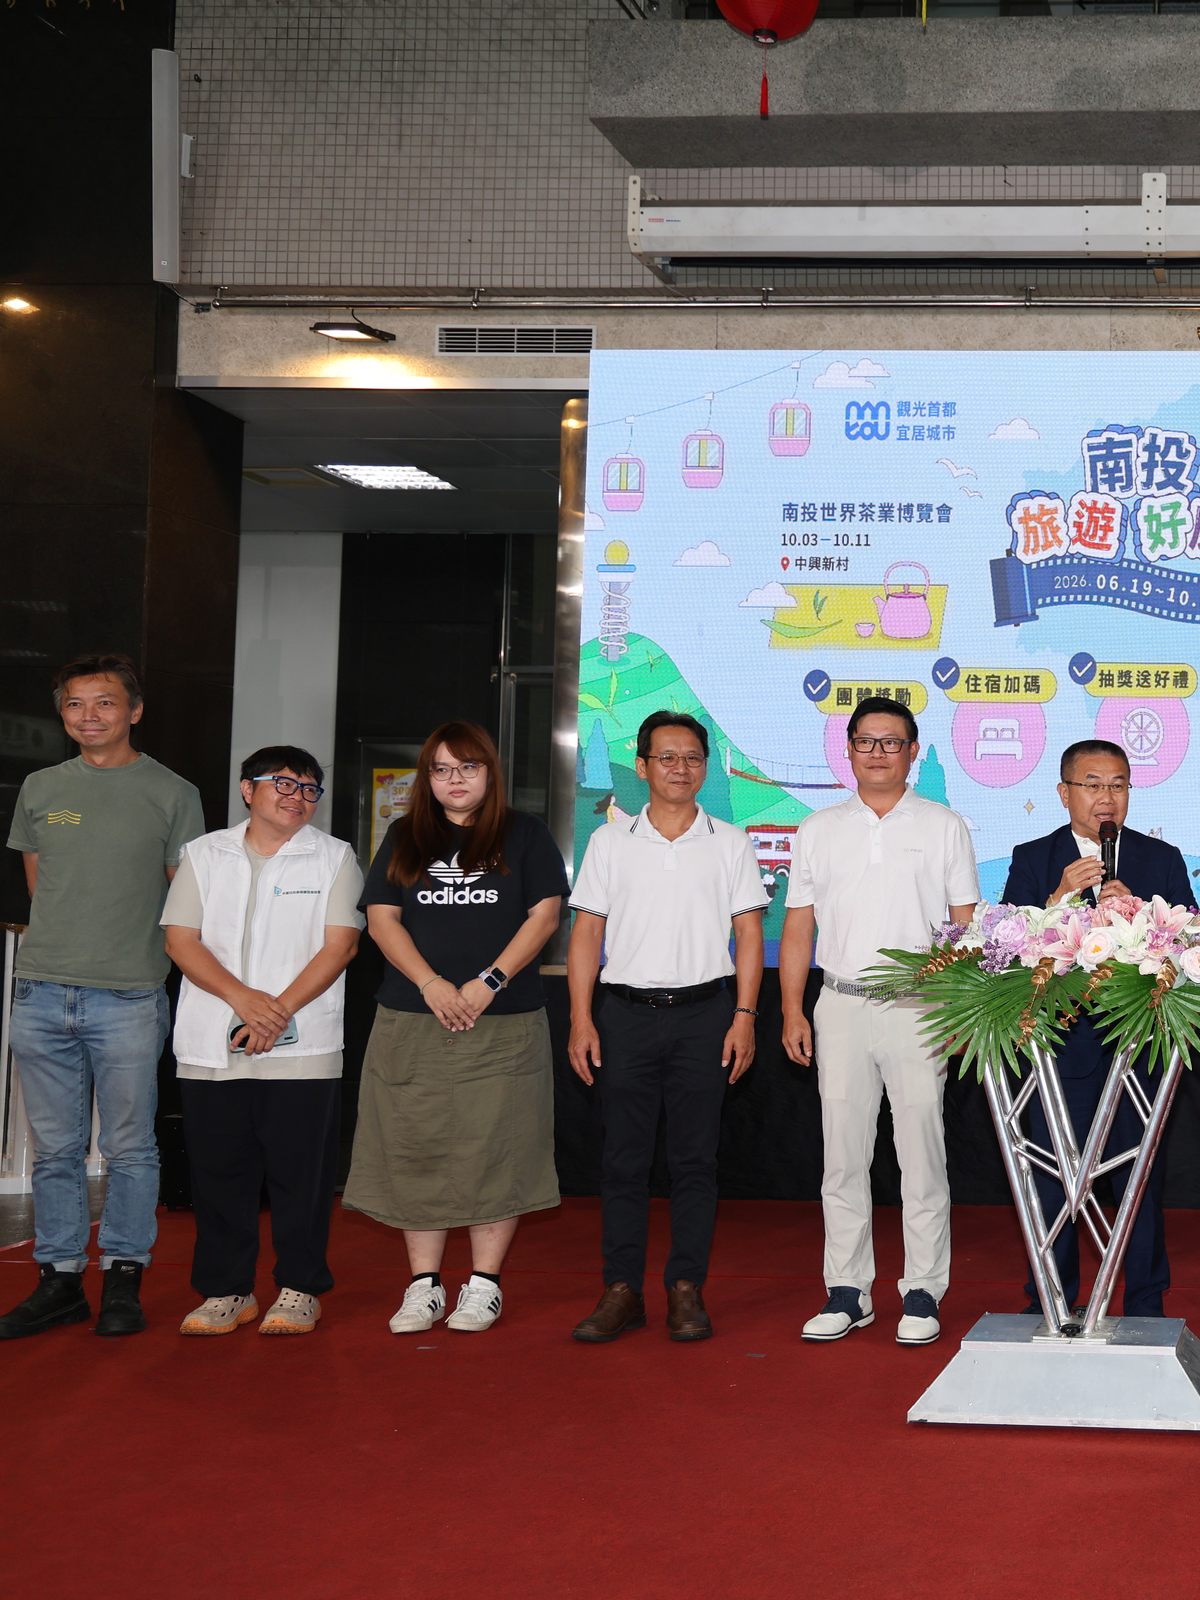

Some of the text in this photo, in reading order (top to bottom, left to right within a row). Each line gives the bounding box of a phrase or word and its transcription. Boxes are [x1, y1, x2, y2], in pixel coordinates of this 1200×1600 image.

[896, 400, 957, 418] 觀光首都
[896, 424, 957, 442] 宜居城市
[1086, 432, 1191, 493] 南投
[781, 502, 954, 524] 南投世界茶業博覽會
[794, 555, 849, 572] 中興新村
[964, 673, 1041, 694] 住宿加碼
[1098, 668, 1189, 689] 抽獎送好禮
[417, 886, 499, 905] adidas
